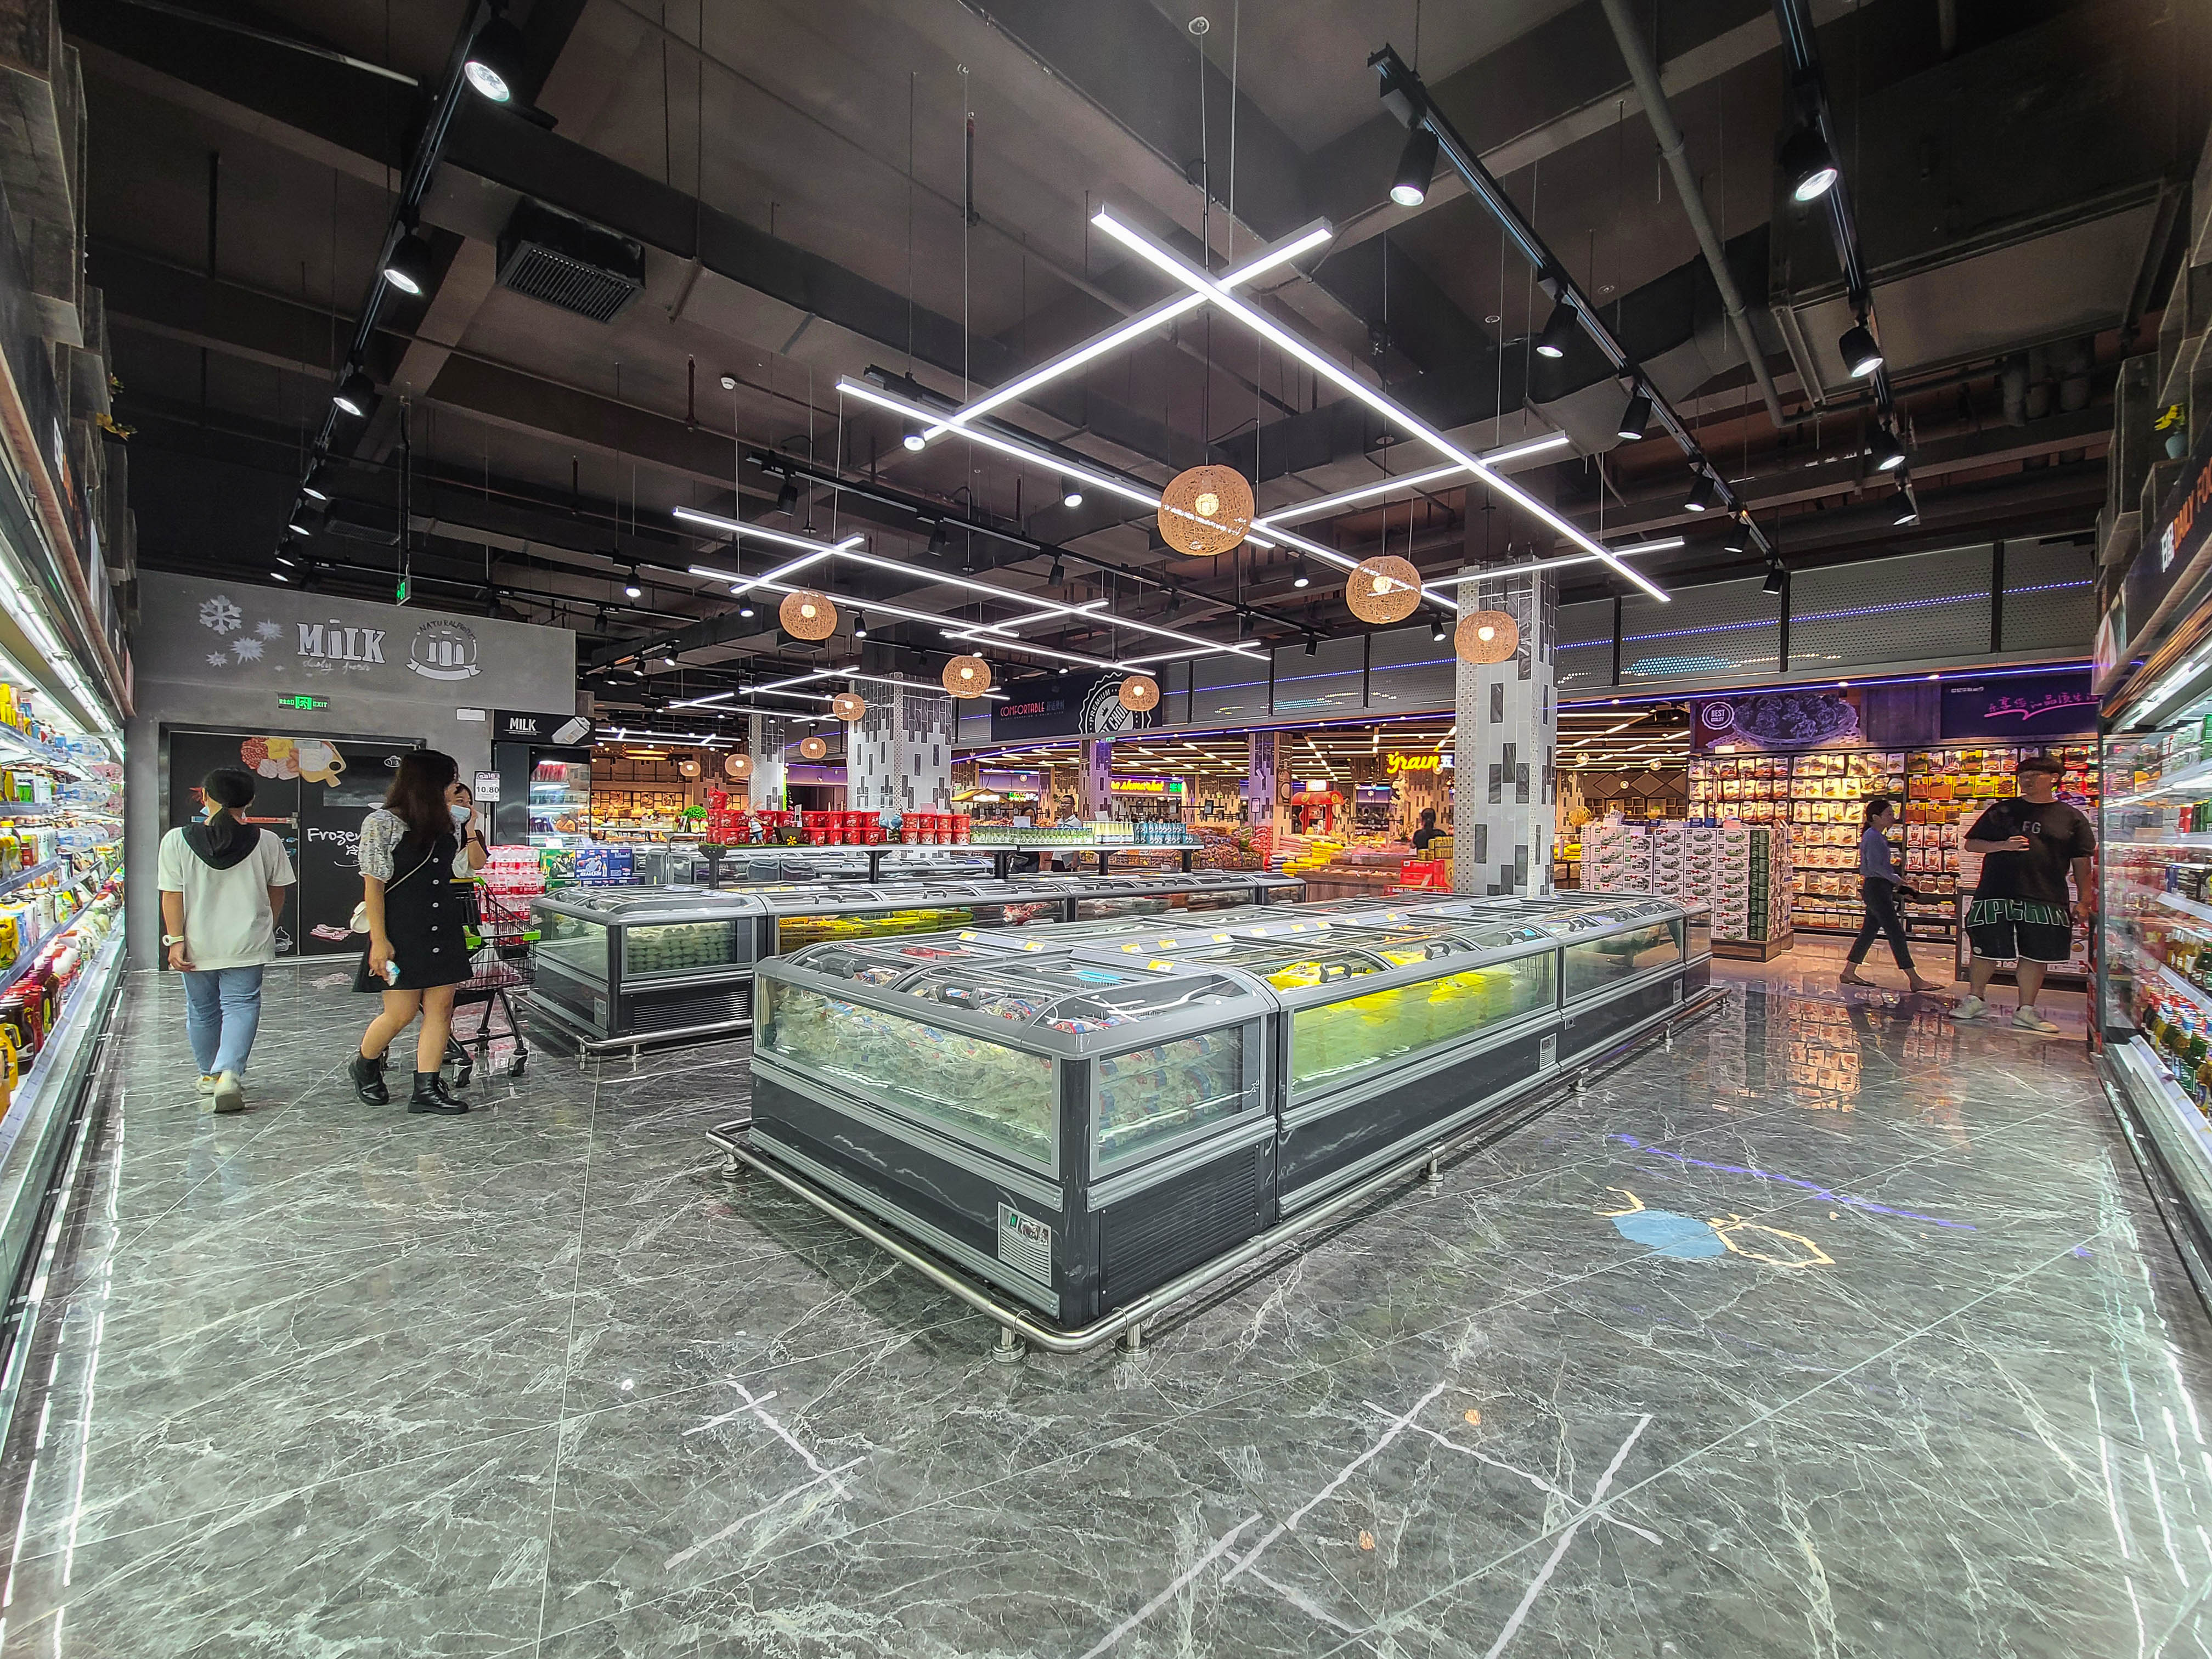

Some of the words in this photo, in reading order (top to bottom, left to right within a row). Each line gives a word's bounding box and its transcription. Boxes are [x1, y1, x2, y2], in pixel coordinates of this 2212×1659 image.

[1001, 702, 1045, 716] COMFORTABLE
[1089, 689, 1110, 723] PREMIUM
[1108, 702, 1128, 731] CHOI
[510, 718, 536, 731] MILK
